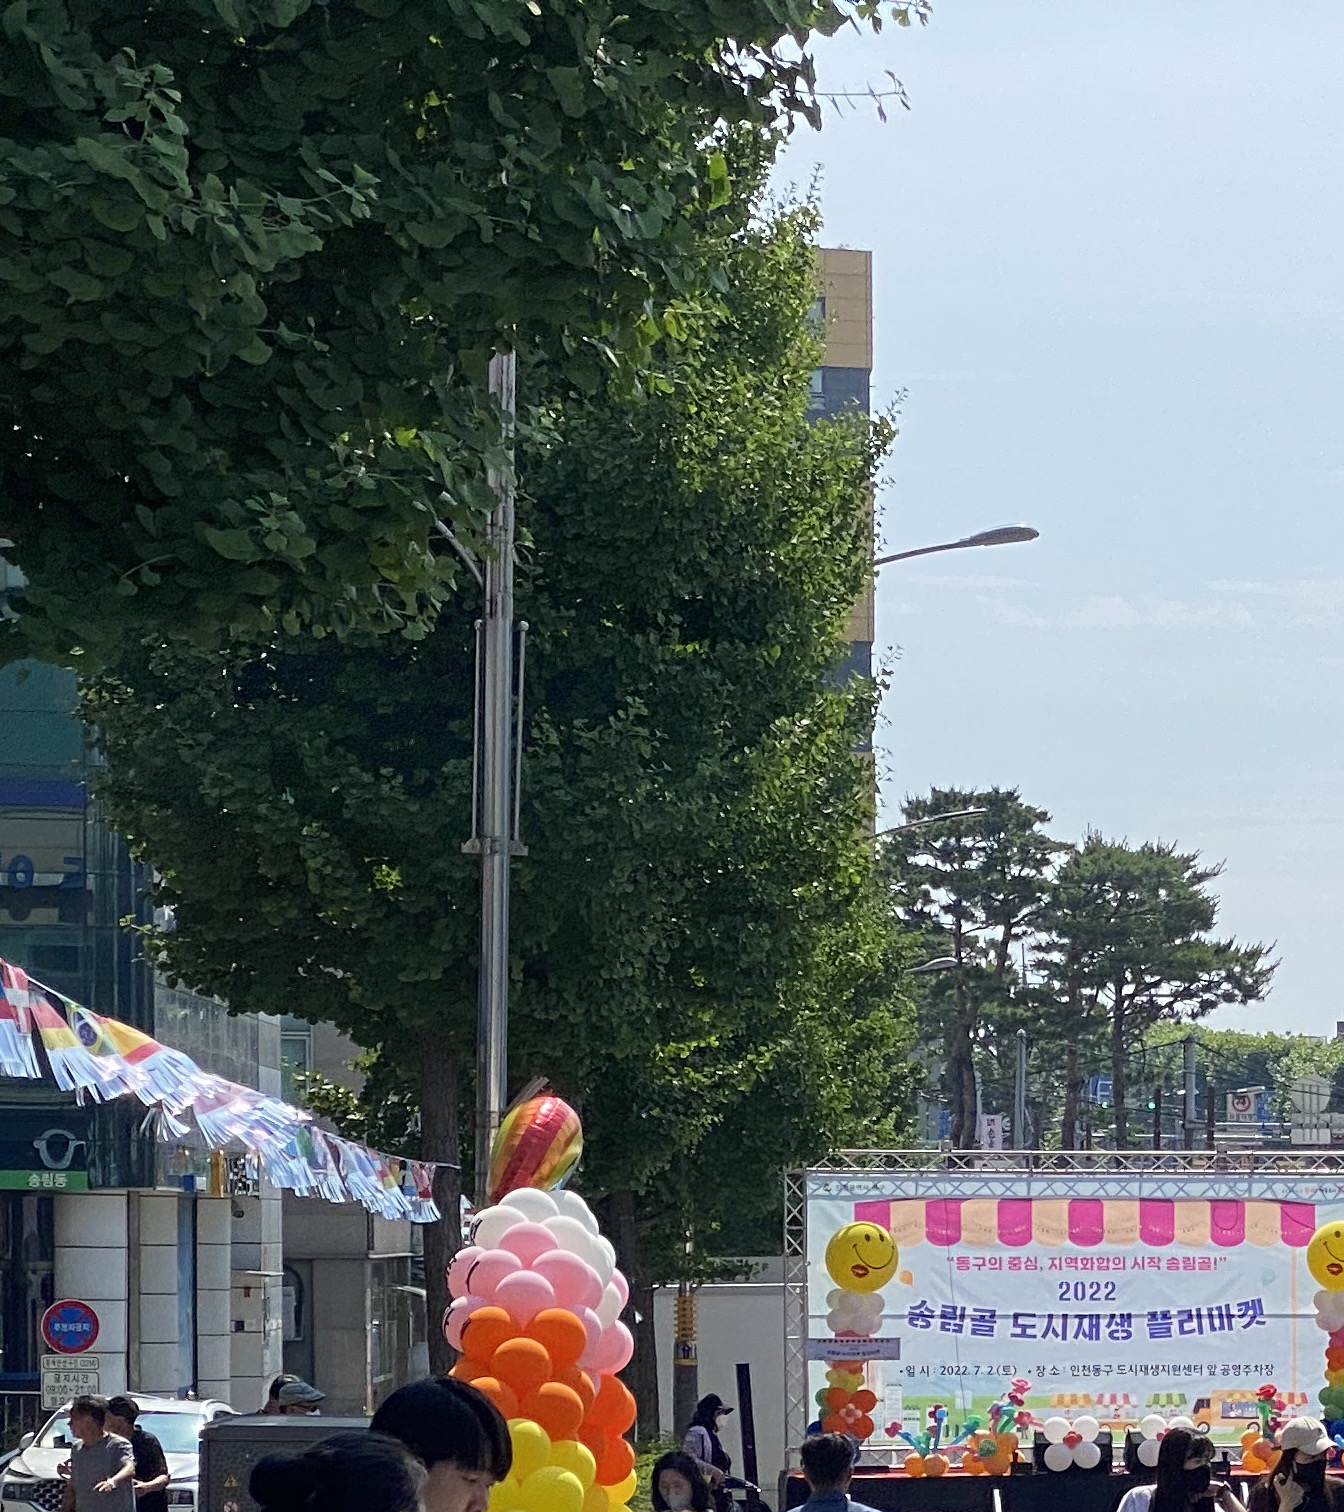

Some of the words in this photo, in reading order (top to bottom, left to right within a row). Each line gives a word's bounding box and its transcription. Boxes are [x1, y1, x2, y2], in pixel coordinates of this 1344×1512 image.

[27, 1172, 69, 1188] 송림동
[1007, 1256, 1044, 1272] 중심,
[1048, 1256, 1126, 1272] 지역화합의
[1130, 1256, 1162, 1272] 시작
[1058, 1281, 1117, 1302] 2022
[907, 1299, 998, 1338] 송림골
[1010, 1310, 1134, 1342] 도시재생
[1146, 1297, 1267, 1339] 플리마켓
[1116, 1364, 1203, 1377] 도시재생지원센터
[1206, 1364, 1218, 1377] 앞
[1219, 1364, 1275, 1377] 공영주차장
